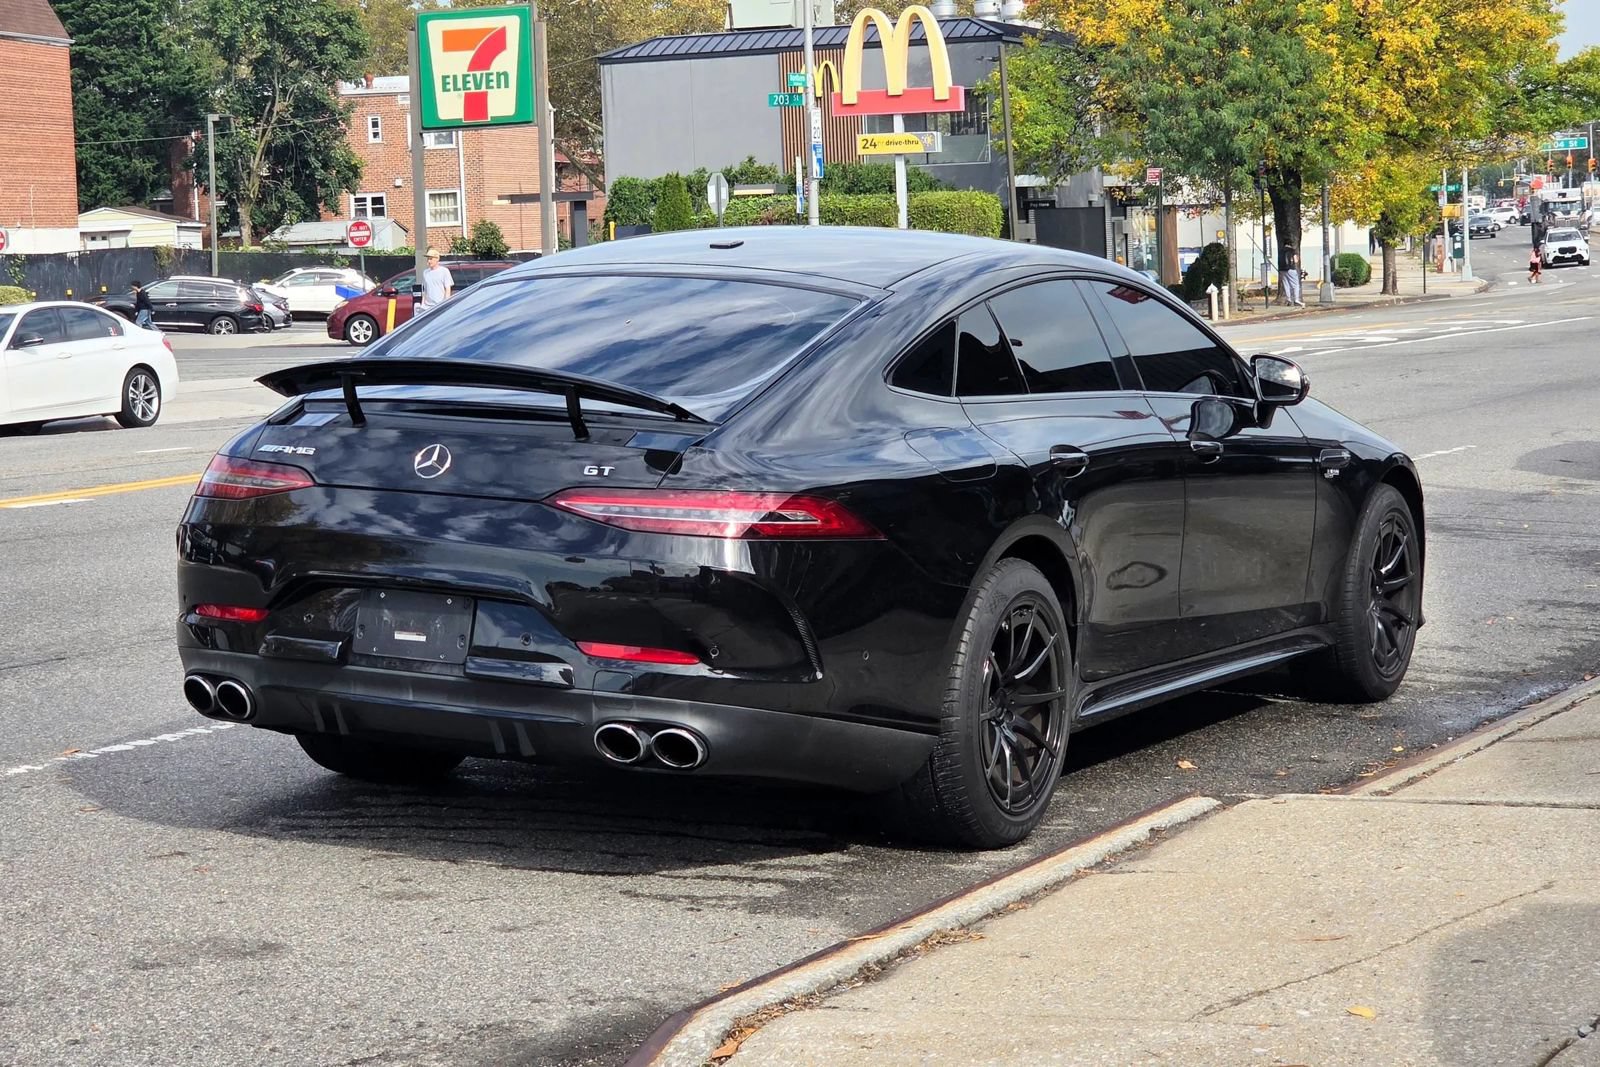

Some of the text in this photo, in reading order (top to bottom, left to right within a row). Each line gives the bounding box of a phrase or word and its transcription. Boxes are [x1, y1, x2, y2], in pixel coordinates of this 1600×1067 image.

[442, 26, 507, 121] 7
[773, 94, 790, 105] 203
[861, 138, 877, 150] 24
[272, 445, 316, 455] AMG
[583, 465, 616, 476] GT
